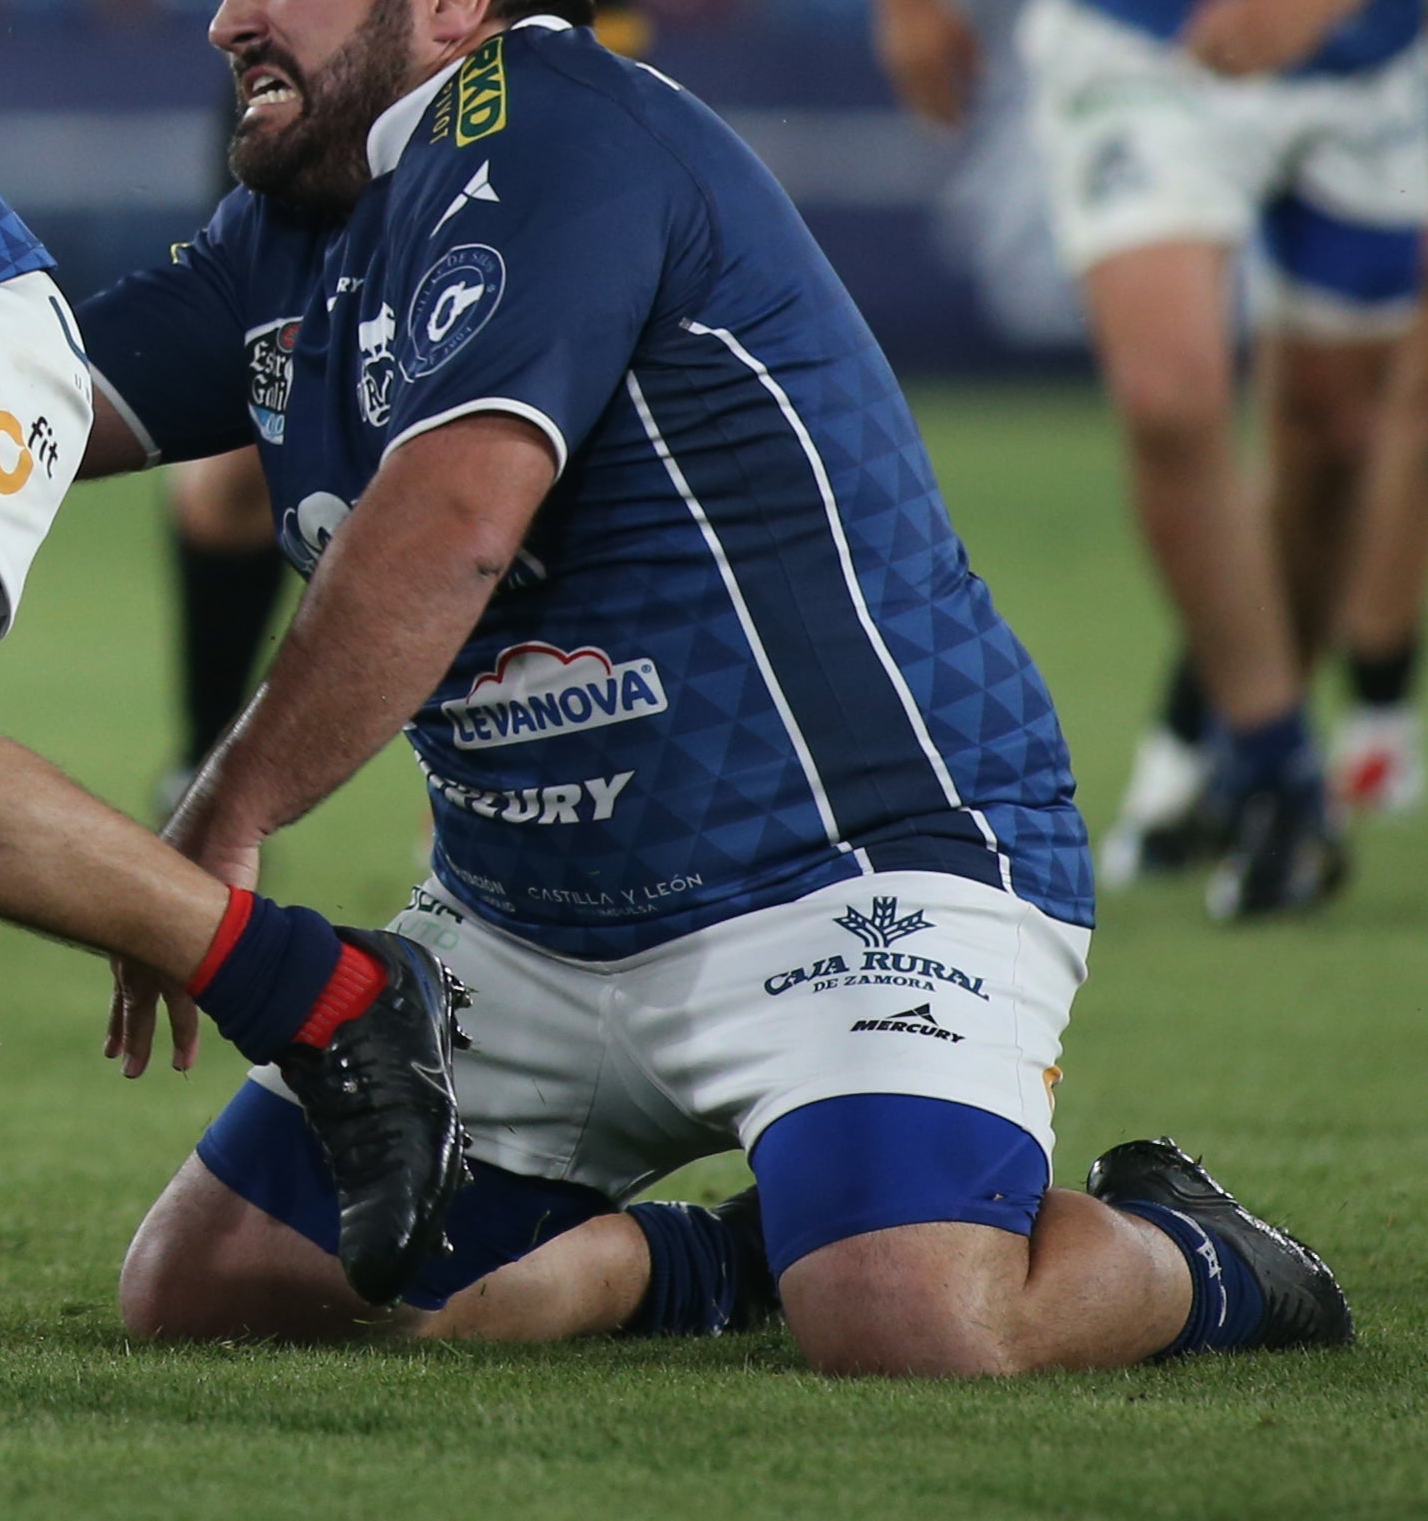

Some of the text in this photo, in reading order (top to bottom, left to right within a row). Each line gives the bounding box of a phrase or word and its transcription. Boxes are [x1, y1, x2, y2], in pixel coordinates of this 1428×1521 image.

[28, 416, 58, 479] fit
[446, 670, 658, 743] LEVANOVA
[527, 886, 614, 906] CASTILLA
[621, 889, 635, 905] Y
[642, 873, 703, 900] LEÓN
[764, 951, 991, 1002] CAJA RURAL
[812, 975, 937, 994] DE ZAMORA
[849, 1019, 967, 1044] MERCURY
